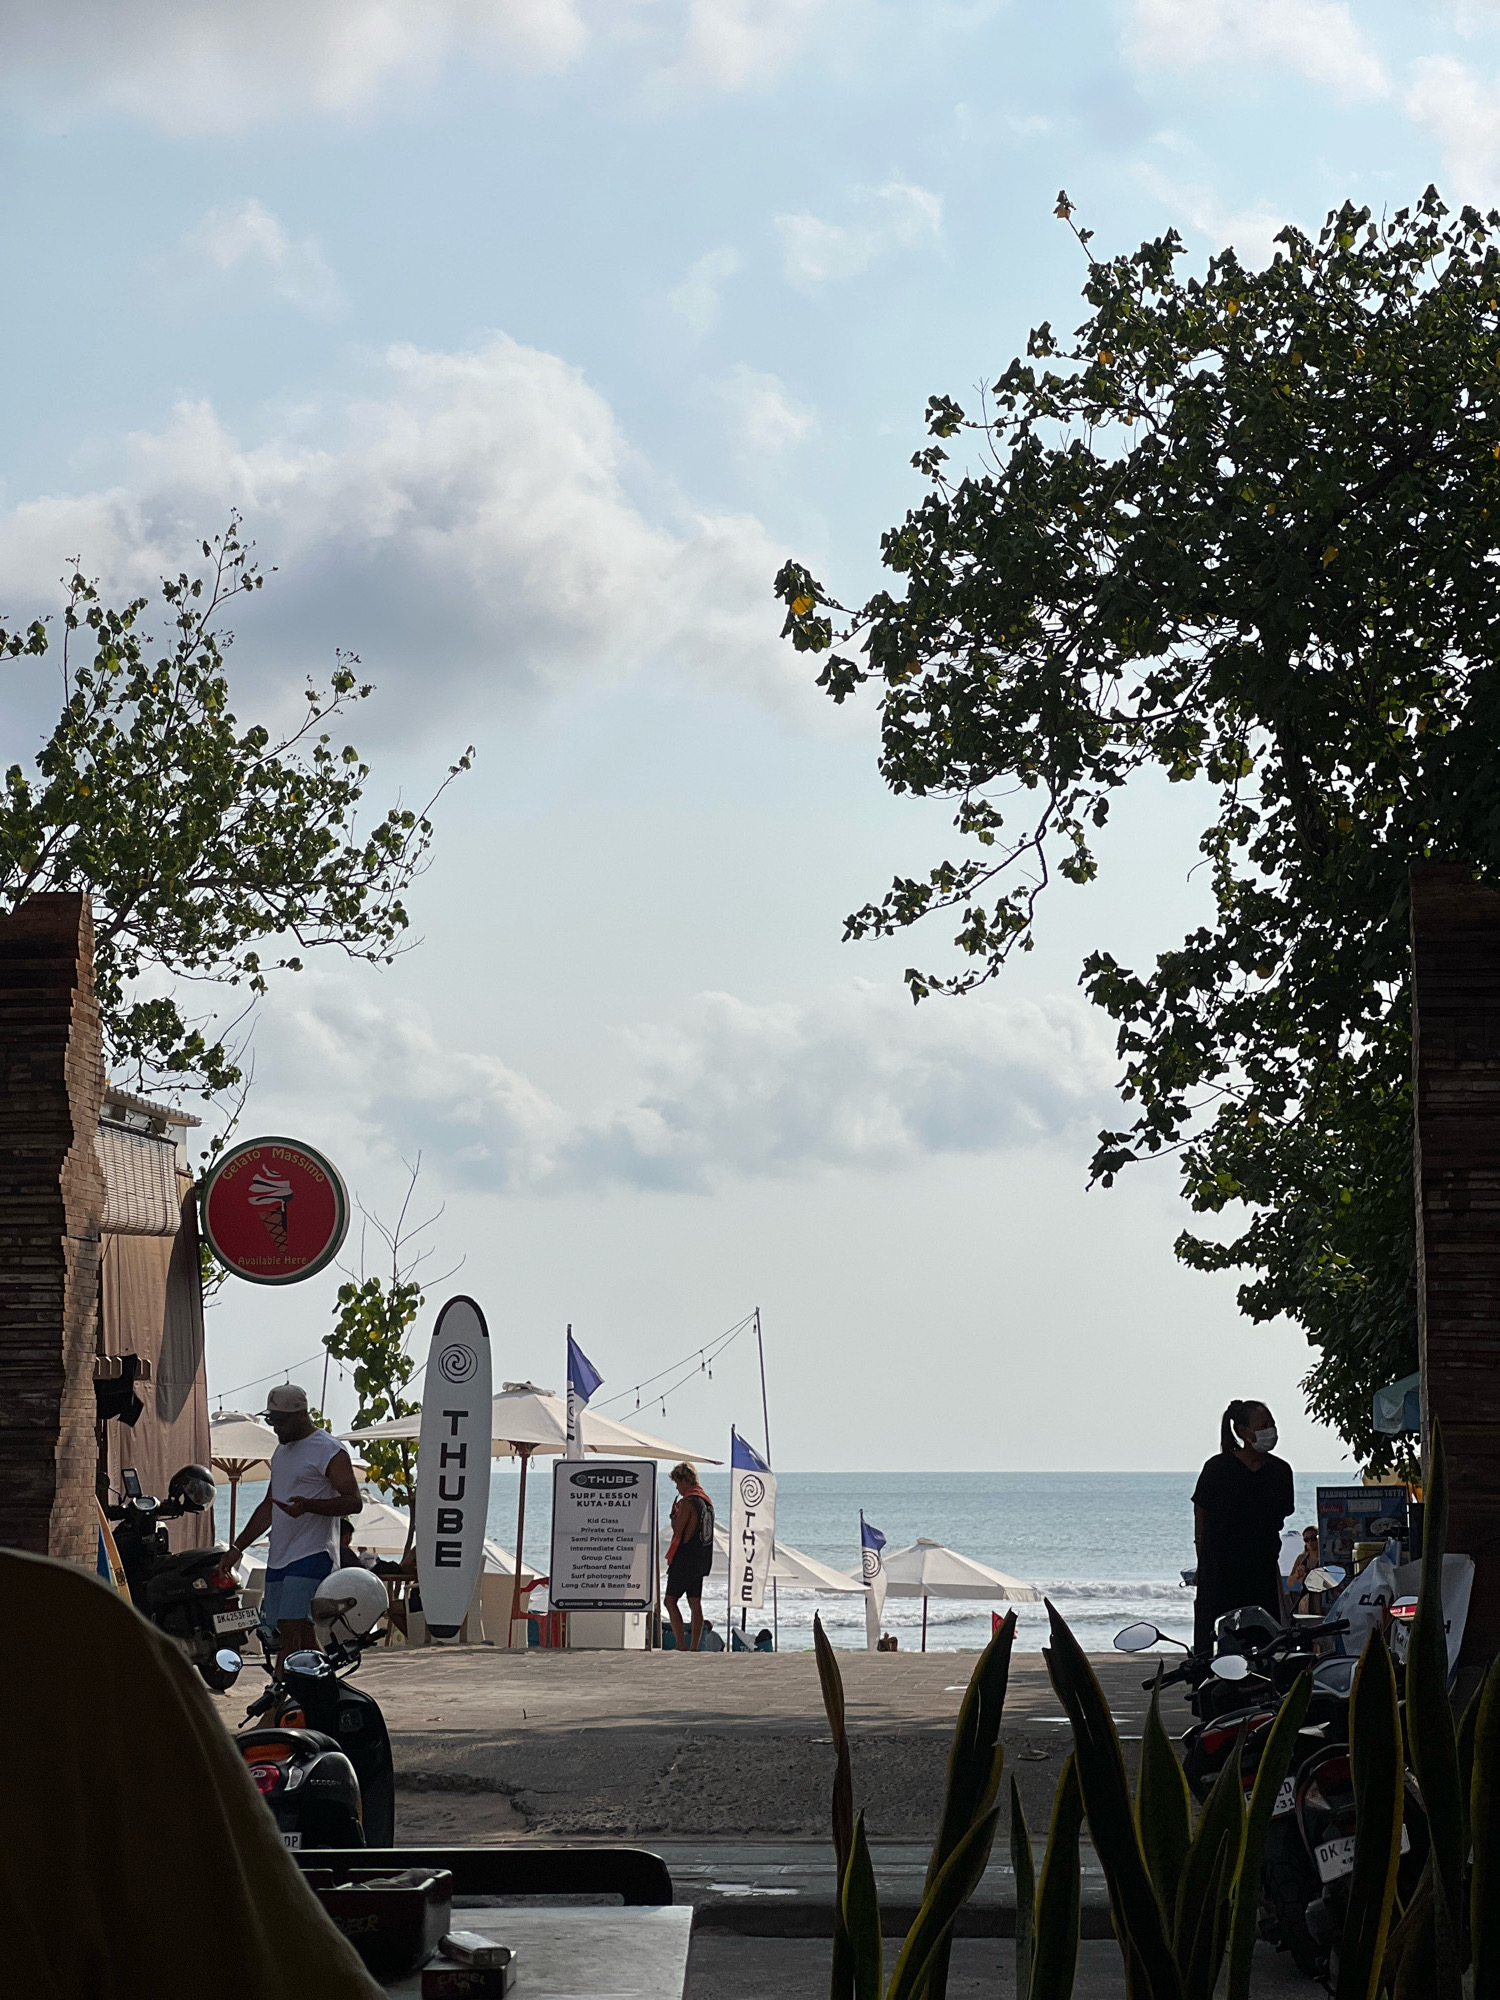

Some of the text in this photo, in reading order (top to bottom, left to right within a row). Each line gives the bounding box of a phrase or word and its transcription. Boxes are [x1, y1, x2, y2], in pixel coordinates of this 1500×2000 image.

[222, 1147, 325, 1183] Gelato Massimo
[238, 1255, 307, 1266] Available Here
[587, 1475, 634, 1484] THUBE
[434, 1410, 469, 1568] THUBE
[587, 1517, 619, 1525] Kid Class
[581, 1554, 622, 1562] Group Class
[741, 1511, 756, 1602] THUBE
[572, 1563, 631, 1571] Surfboard Rental
[586, 1573, 632, 1581] photography
[561, 1582, 579, 1590] Long
[626, 1582, 641, 1590] Bag
